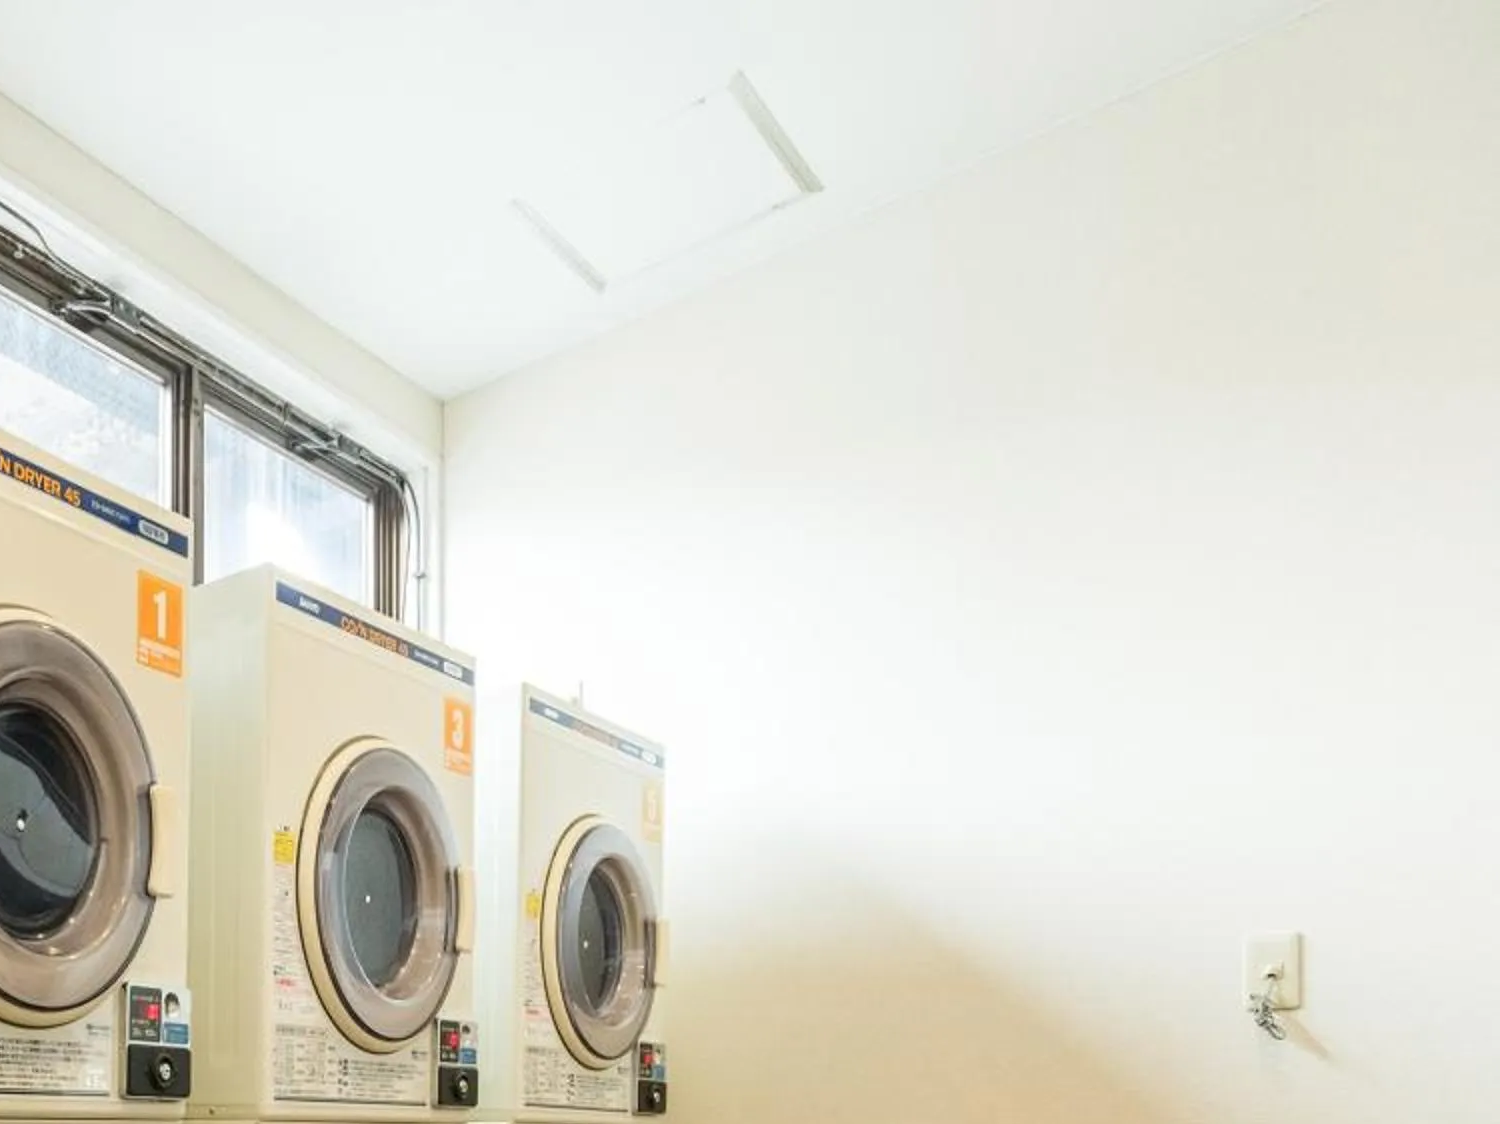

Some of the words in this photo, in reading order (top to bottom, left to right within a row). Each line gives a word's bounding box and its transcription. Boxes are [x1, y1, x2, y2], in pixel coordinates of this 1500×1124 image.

[14, 462, 61, 497] DRYER
[64, 487, 81, 507] 45
[153, 590, 167, 642] 1
[451, 709, 464, 750] 3
